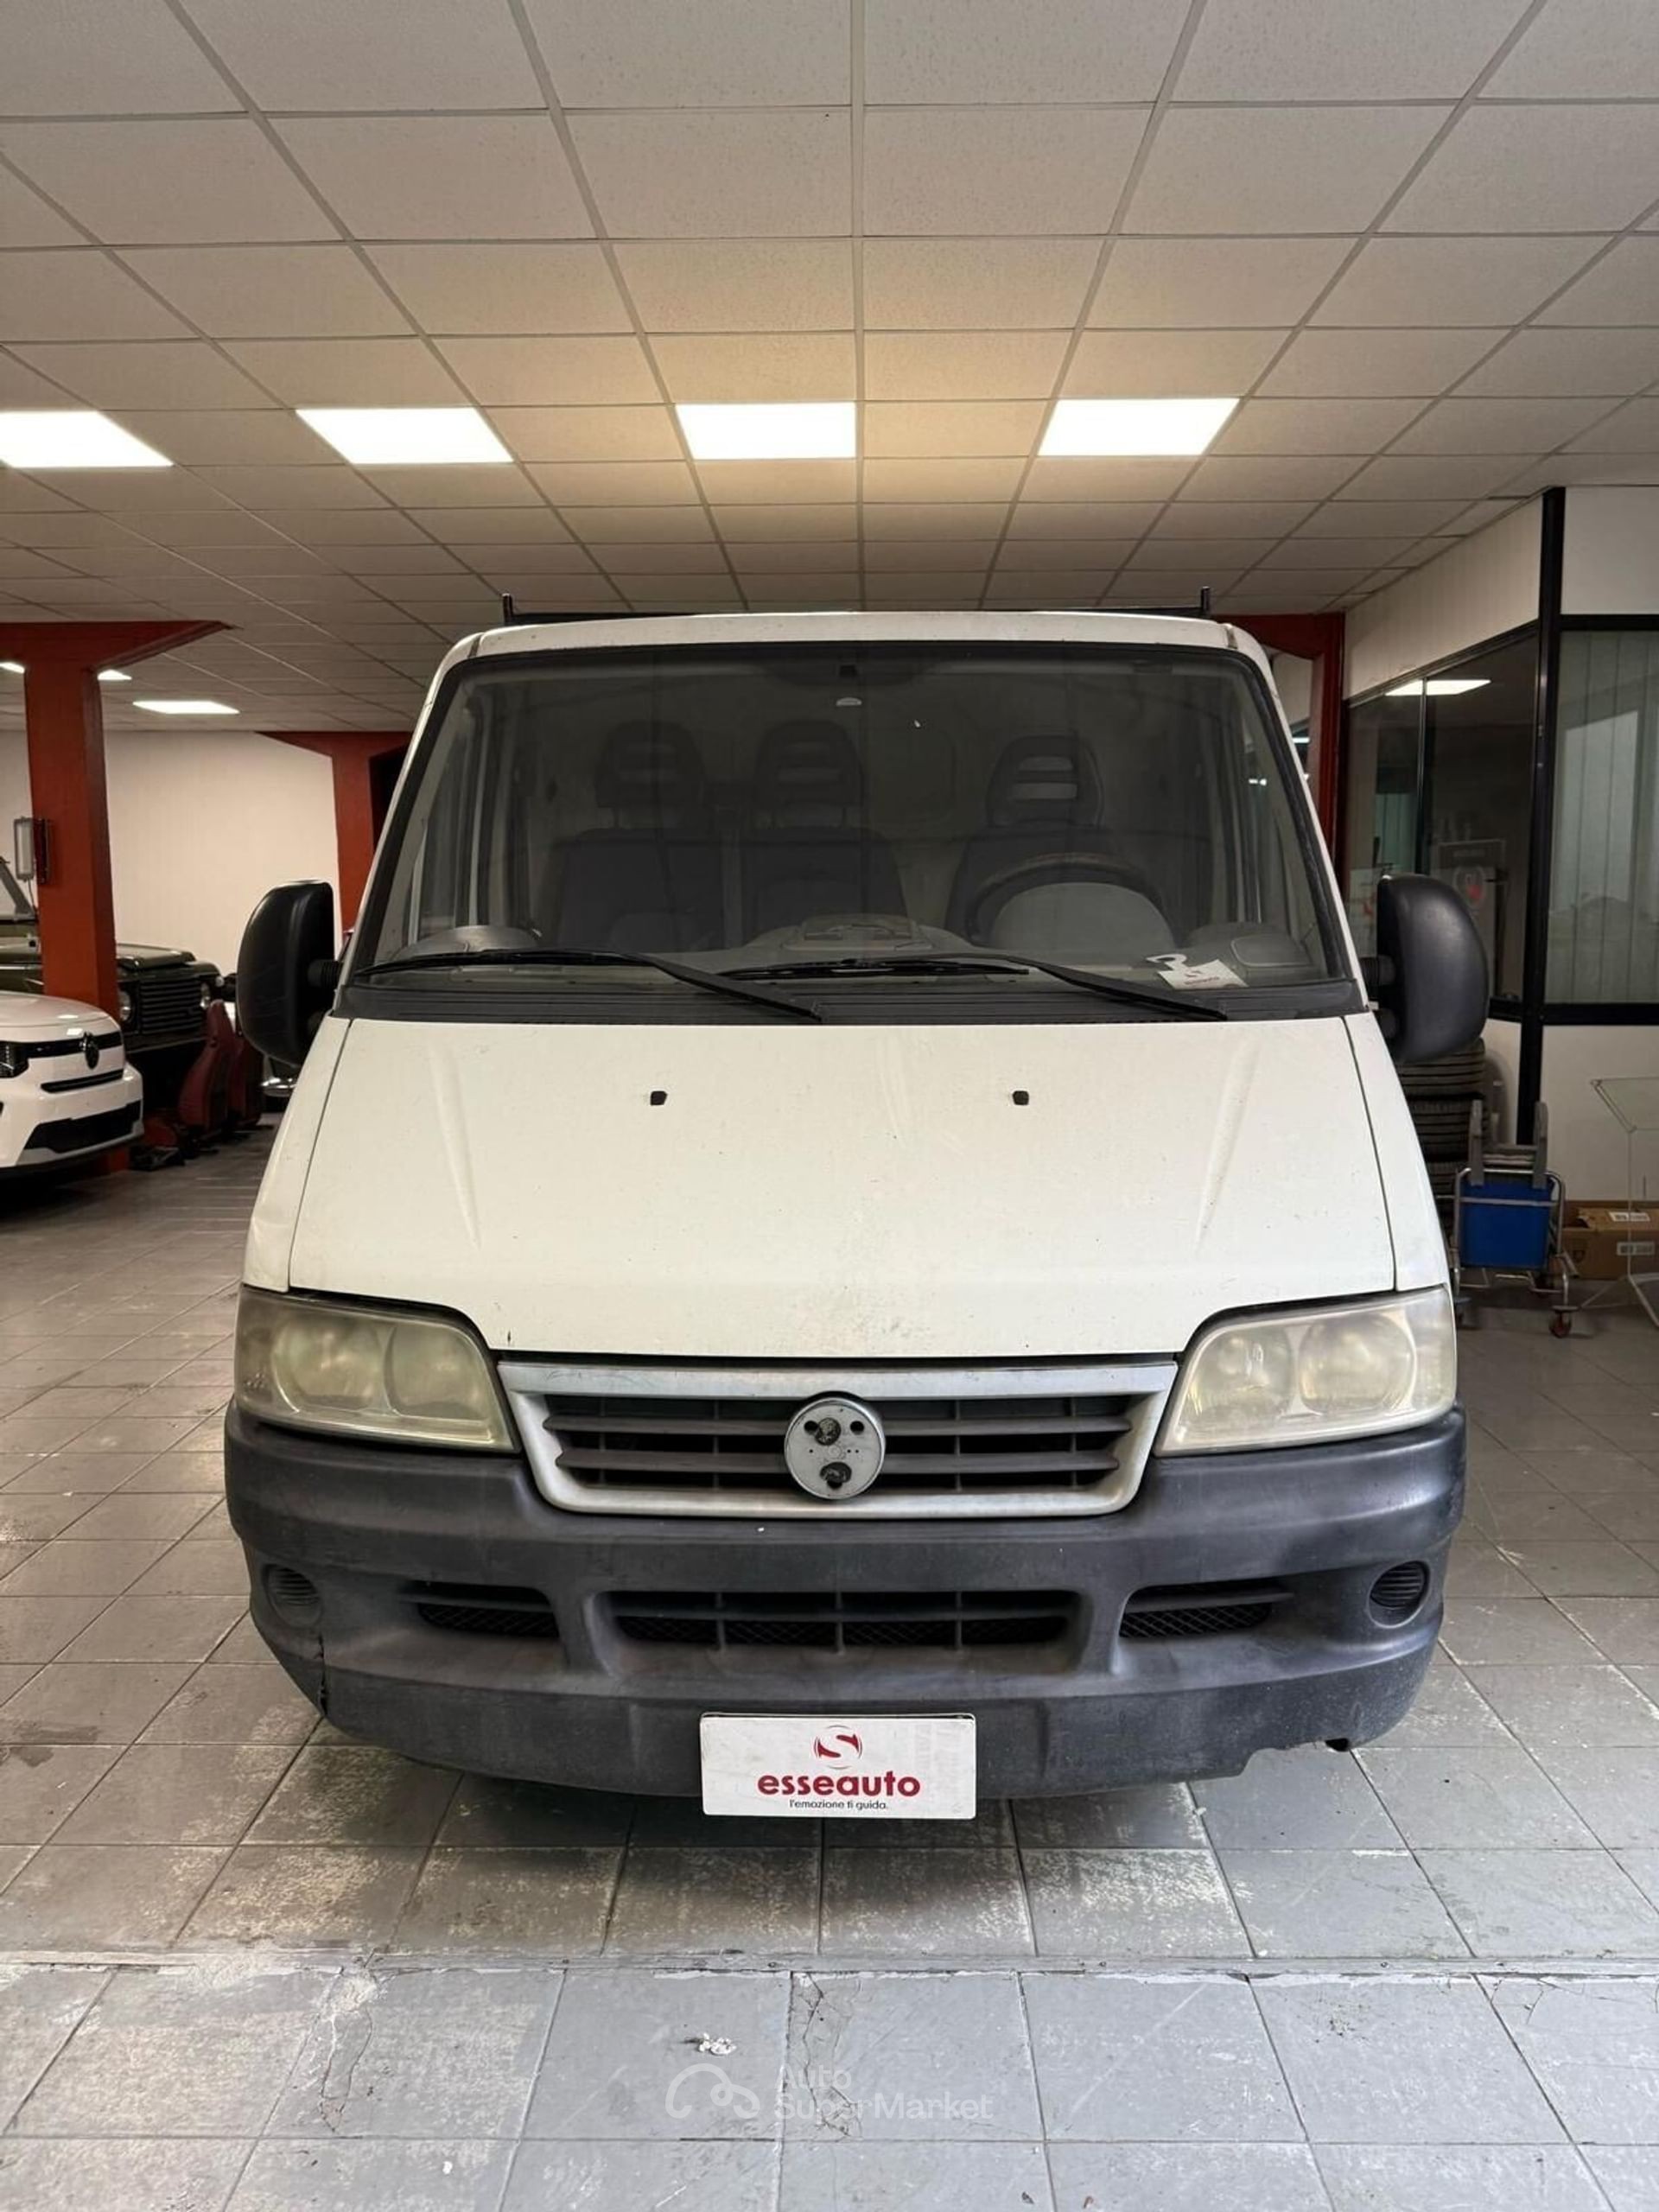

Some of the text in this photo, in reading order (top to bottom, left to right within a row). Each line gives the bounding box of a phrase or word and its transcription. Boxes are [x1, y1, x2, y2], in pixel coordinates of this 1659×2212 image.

[758, 1771, 921, 1796] esseauto
[790, 1800, 888, 1811] l'emozione ti guida.
